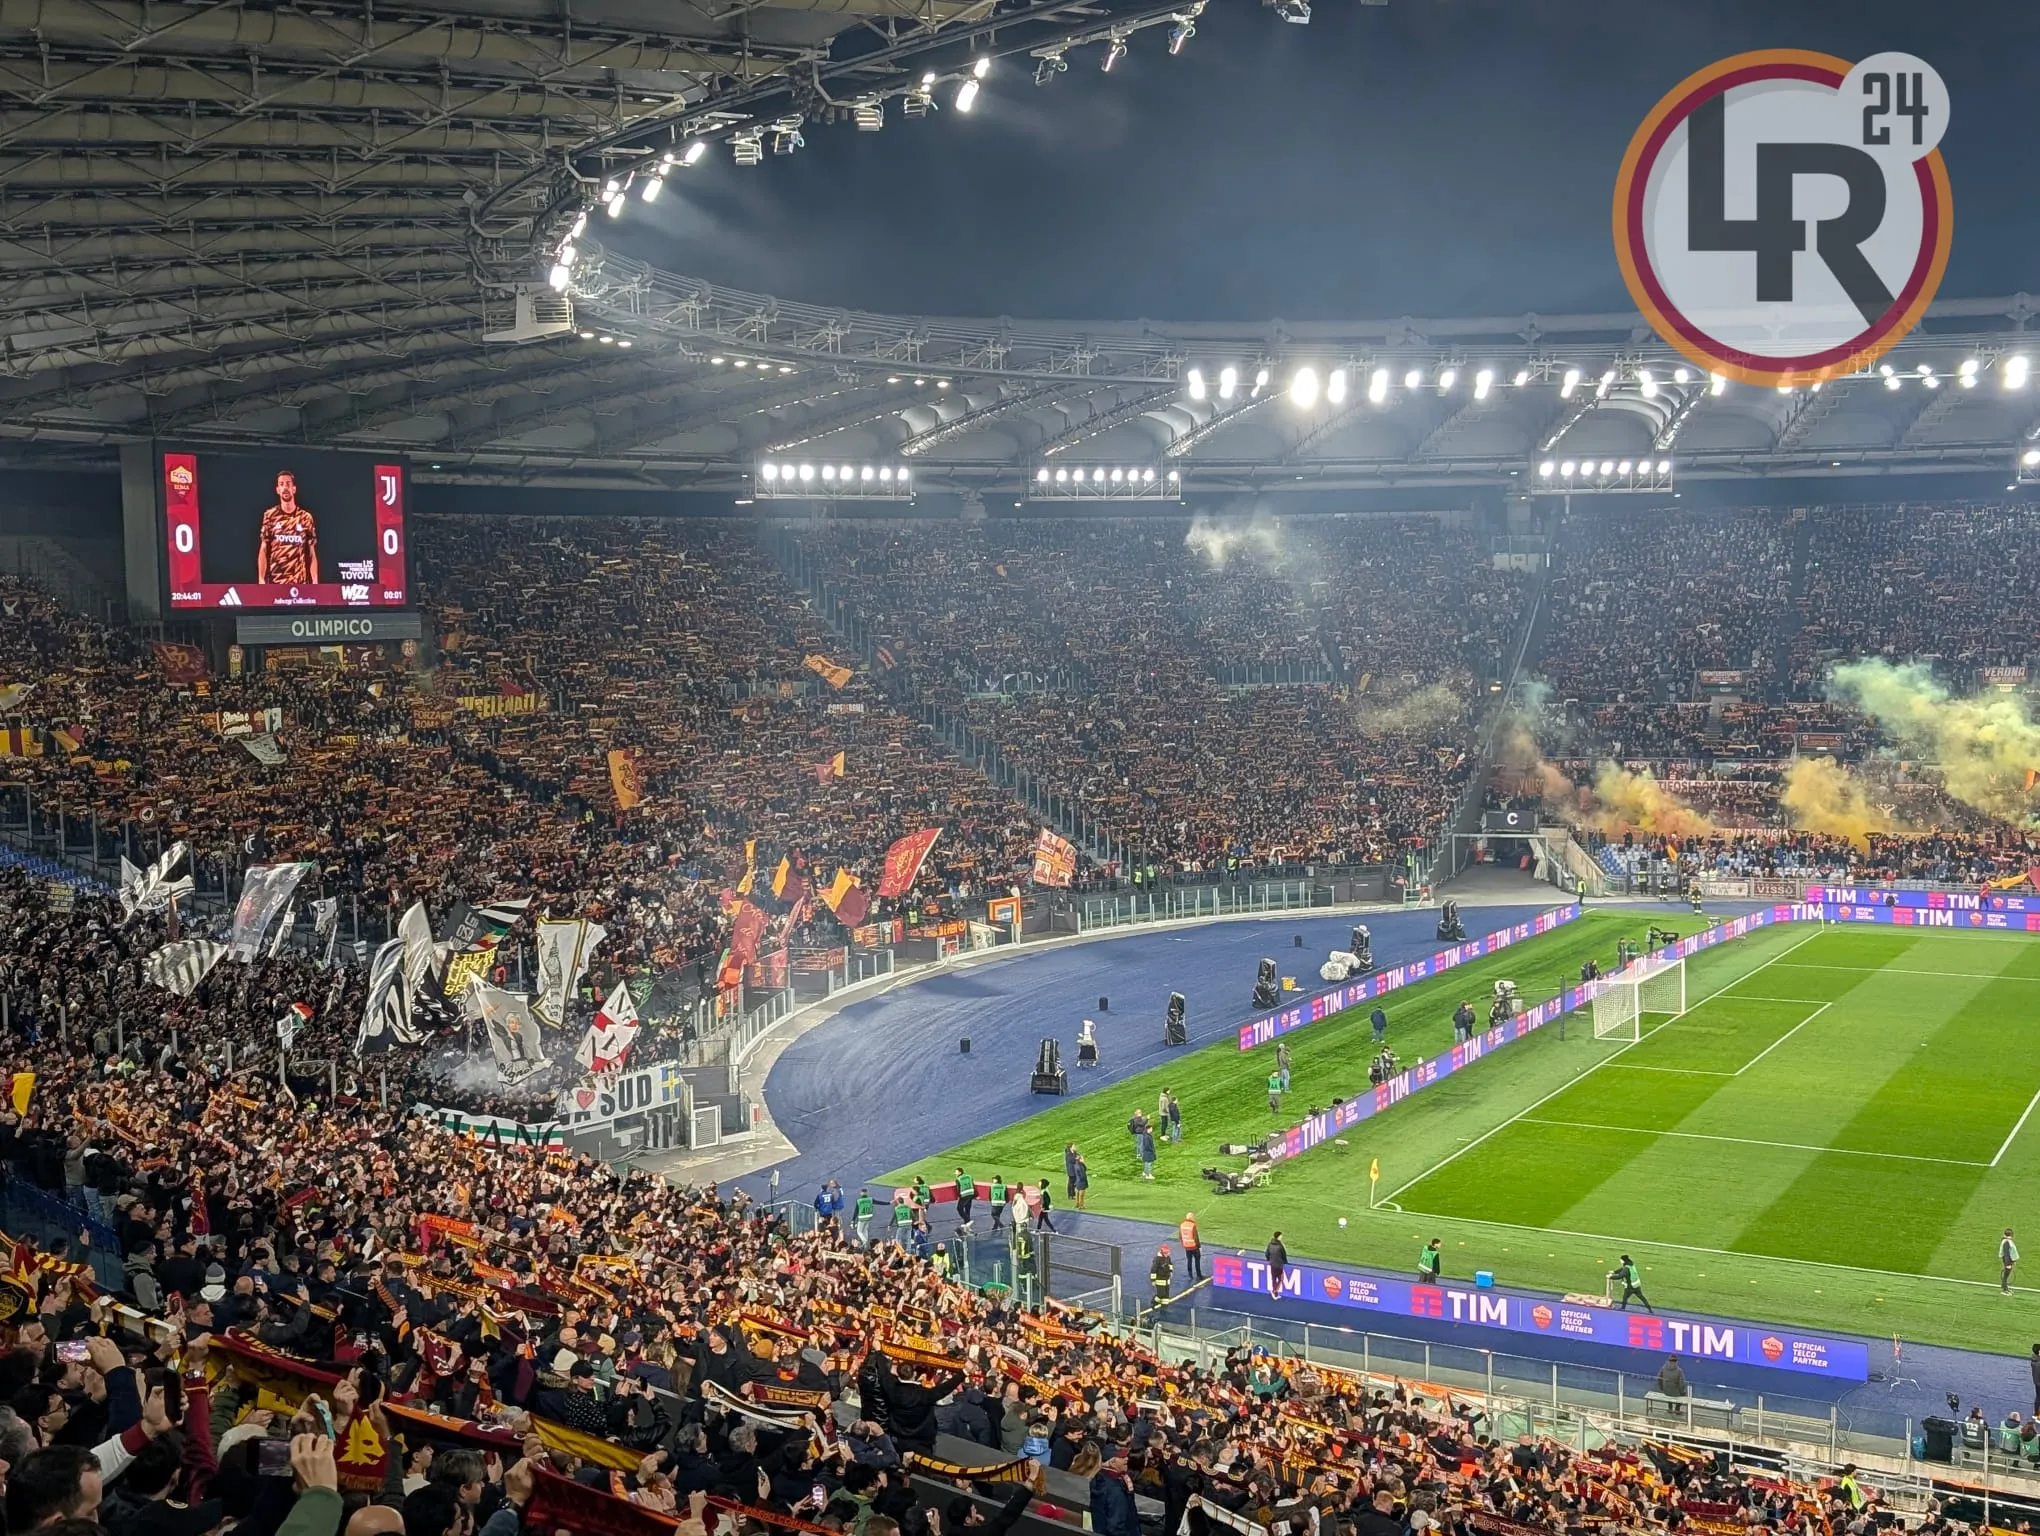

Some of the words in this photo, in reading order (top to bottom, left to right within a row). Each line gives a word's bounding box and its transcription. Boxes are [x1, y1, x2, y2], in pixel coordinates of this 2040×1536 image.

[175, 524, 193, 552] 0
[275, 534, 303, 543] TOYOTA
[383, 529, 398, 555] 0
[341, 571, 374, 580] TOYOTA
[172, 592, 201, 600] 20:44:01
[341, 584, 369, 600] WIZZ
[384, 591, 402, 600] 00:01
[292, 619, 372, 636] OLIMPICO
[1984, 667, 2026, 677] VERONA
[413, 710, 442, 720] FORZA
[1506, 812, 1518, 825] C
[1756, 886, 1794, 895] VISSO
[1825, 888, 1856, 904] TIM
[1947, 894, 1979, 910] TIM
[1791, 904, 1822, 920] TIM
[1916, 908, 1953, 926] TIM
[1543, 910, 1556, 932] TIM
[1733, 916, 1746, 936] TIM
[1496, 928, 1510, 950] TIM
[1444, 946, 1460, 969] TIM
[1386, 966, 1404, 990] TIM
[1323, 990, 1342, 1016] TIM
[1527, 1004, 1544, 1032] TIM
[1252, 1016, 1274, 1045] TIM
[1463, 1036, 1481, 1064] TIM
[600, 1074, 653, 1117] SUD
[1388, 1072, 1409, 1104] TIM
[1302, 1114, 1326, 1150] TIM
[1247, 1262, 1300, 1296] TIM
[1349, 1280, 1377, 1290] OFFICIAL
[1349, 1287, 1370, 1295] TELCO
[1350, 1295, 1379, 1304] PARTNER
[1447, 1290, 1508, 1326] TIM
[1560, 1310, 1592, 1320] OFFICIAL
[1560, 1317, 1582, 1326] TELCO
[1560, 1324, 1593, 1334] PARTNER
[1668, 1322, 1734, 1358] TIM
[1792, 1342, 1826, 1352] OFFICIAL
[1792, 1350, 1816, 1358] TELCO
[1792, 1356, 1828, 1368] PARTNER
